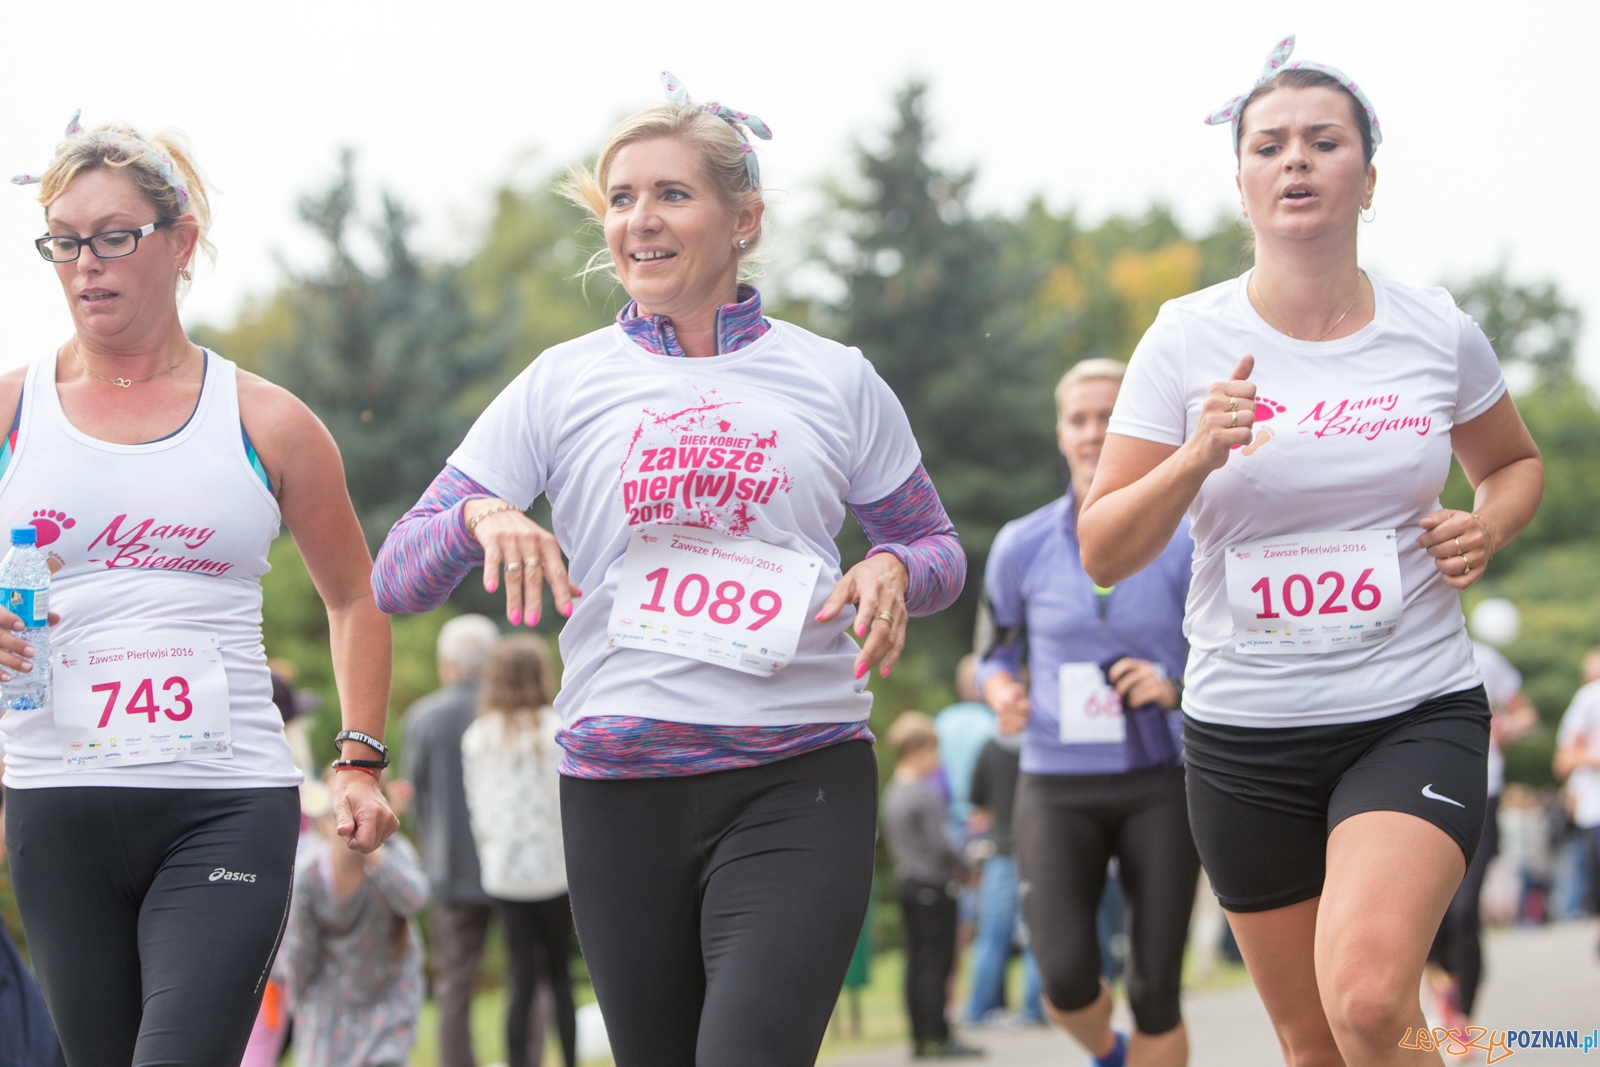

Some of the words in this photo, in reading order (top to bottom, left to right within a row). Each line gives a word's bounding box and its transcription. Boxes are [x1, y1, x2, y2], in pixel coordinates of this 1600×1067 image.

[1298, 394, 1399, 425] Mamy
[680, 435, 707, 446] BIEG
[709, 435, 752, 449] KOBIET
[1297, 415, 1432, 441] Biegamy
[638, 447, 765, 473] zawsze
[628, 502, 674, 526] 2016
[88, 514, 216, 549] Mamy
[88, 543, 234, 577] Biegamy
[670, 539, 709, 555] Zawsze
[711, 547, 755, 565] Pier(w)si
[756, 558, 783, 573] 2016
[1263, 548, 1298, 558] Zawsze
[1301, 544, 1340, 555] Pier(w)si
[1343, 544, 1366, 553] 2016
[639, 567, 783, 631] 1089
[1251, 567, 1382, 620] 1026
[89, 654, 124, 665] Zawsze
[127, 650, 168, 660] Pier(w)si
[171, 647, 194, 657] 2016
[91, 676, 194, 729] 743
